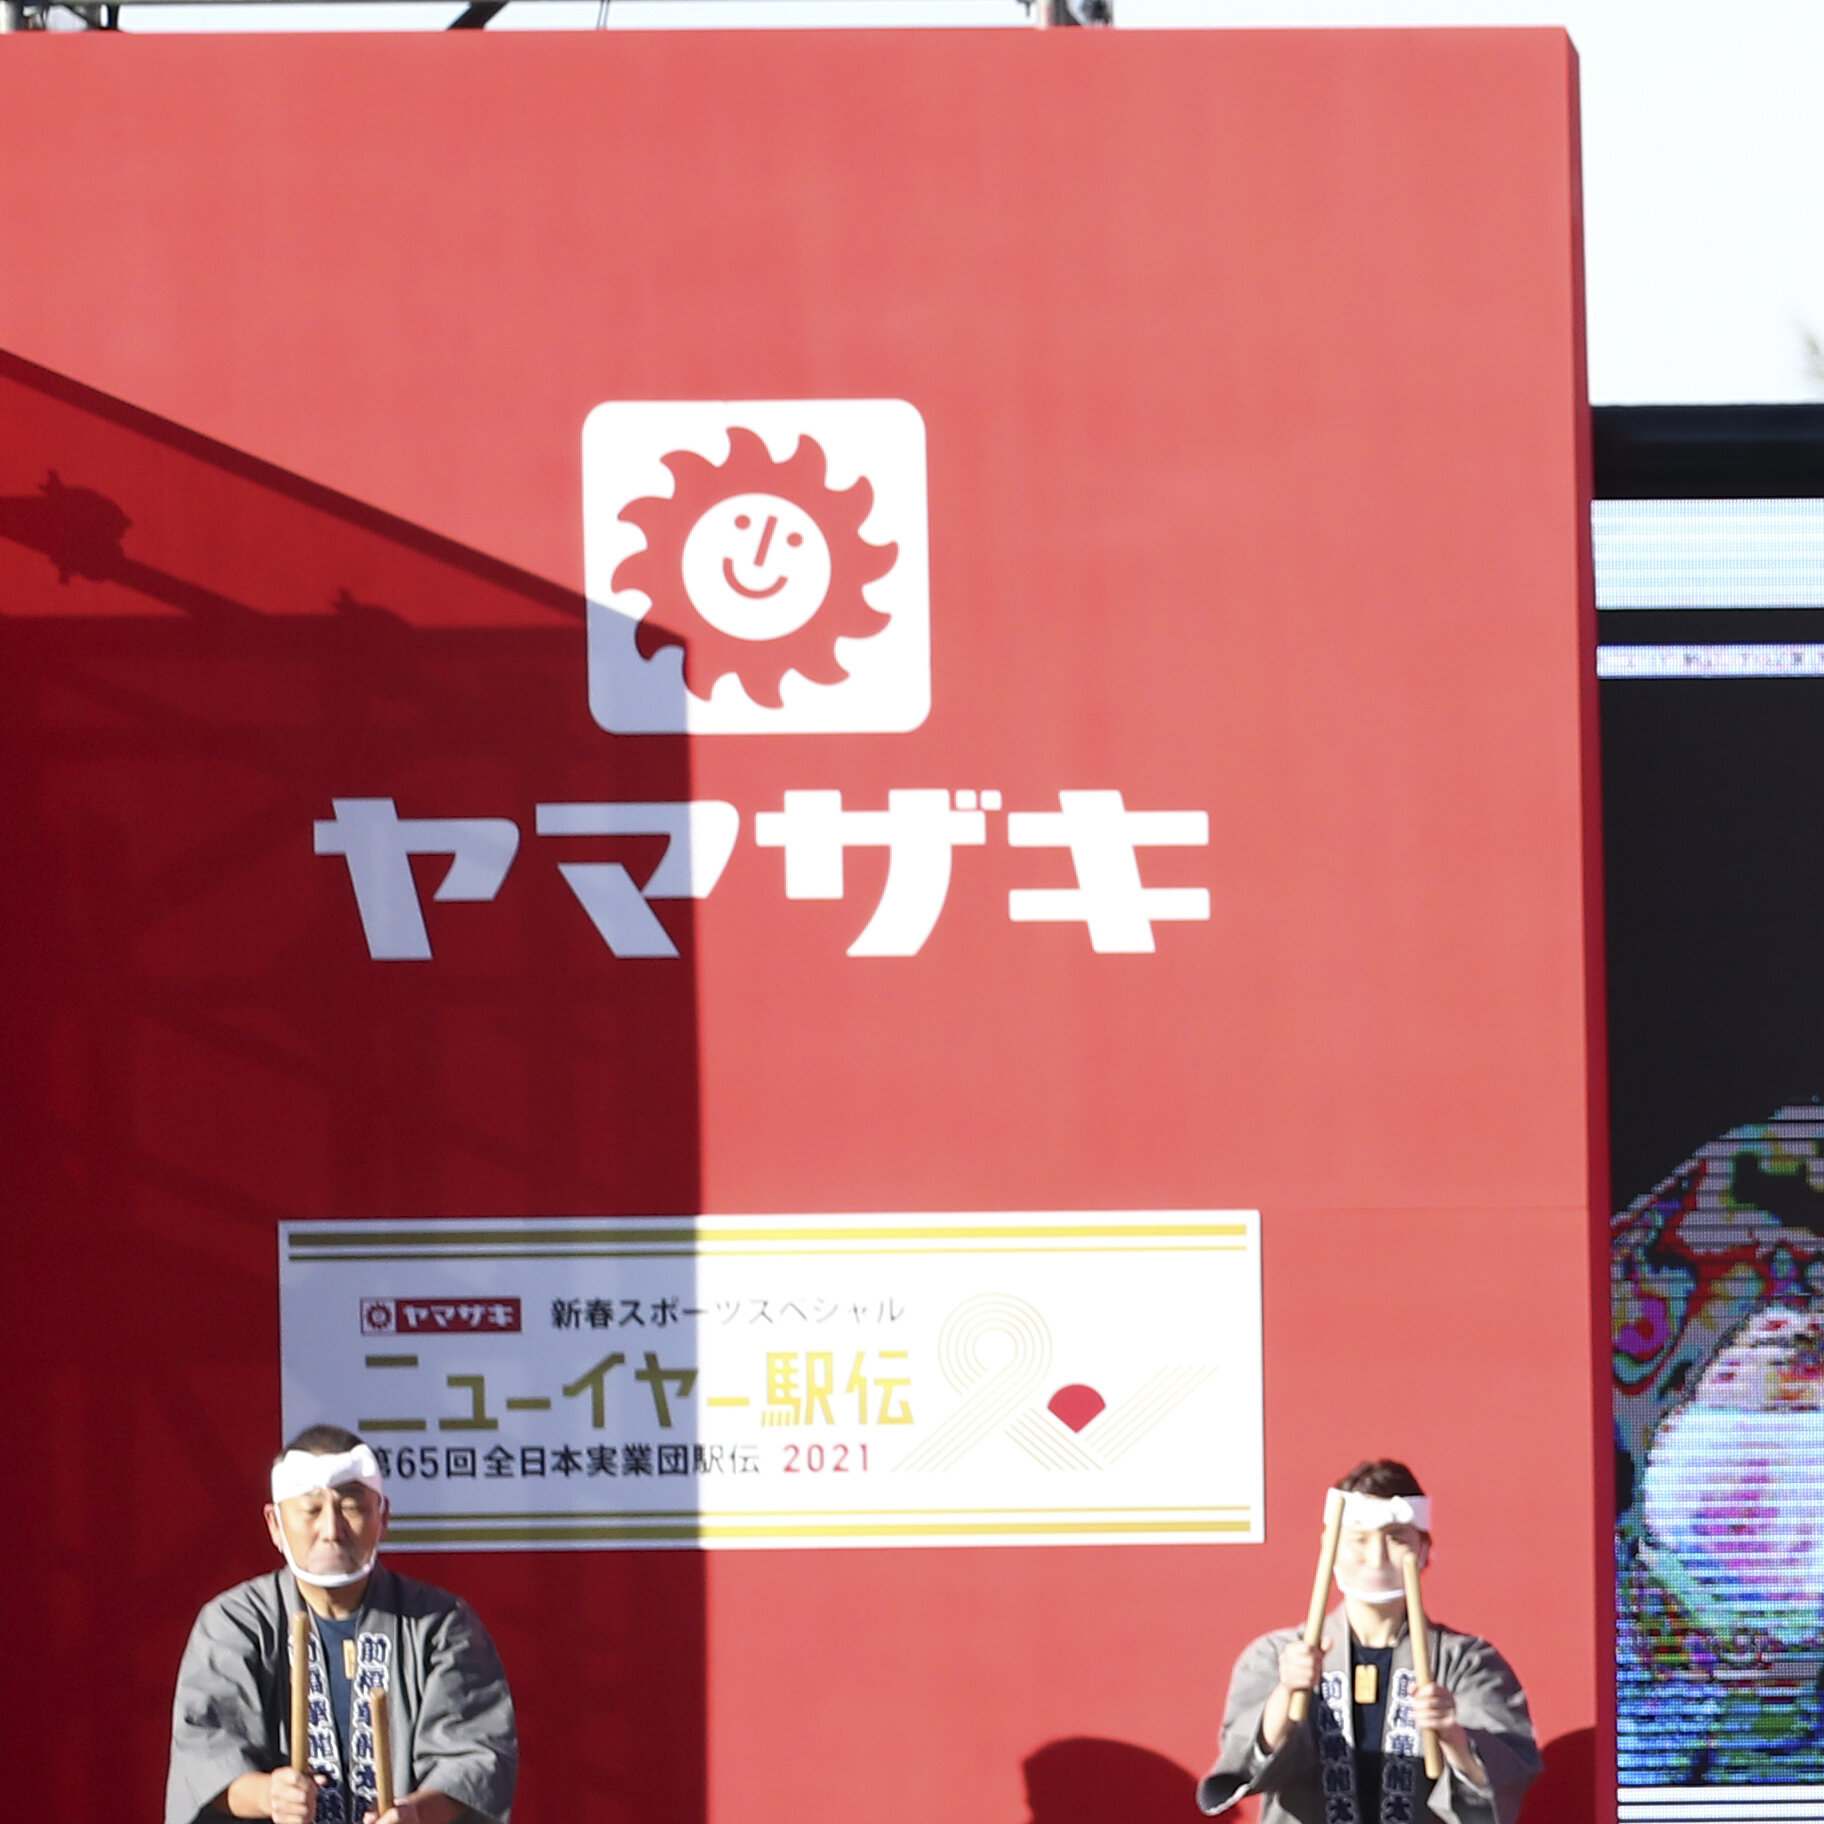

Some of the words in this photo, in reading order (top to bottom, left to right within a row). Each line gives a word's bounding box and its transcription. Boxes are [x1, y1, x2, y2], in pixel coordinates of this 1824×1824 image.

[313, 789, 1210, 962] ヤマザキ
[400, 1303, 517, 1329] ヤマザキ
[551, 1296, 906, 1330] 新春スポーツスペシャル
[357, 1349, 915, 1434] ニューイヤー駅伝
[782, 1442, 872, 1474] 2021
